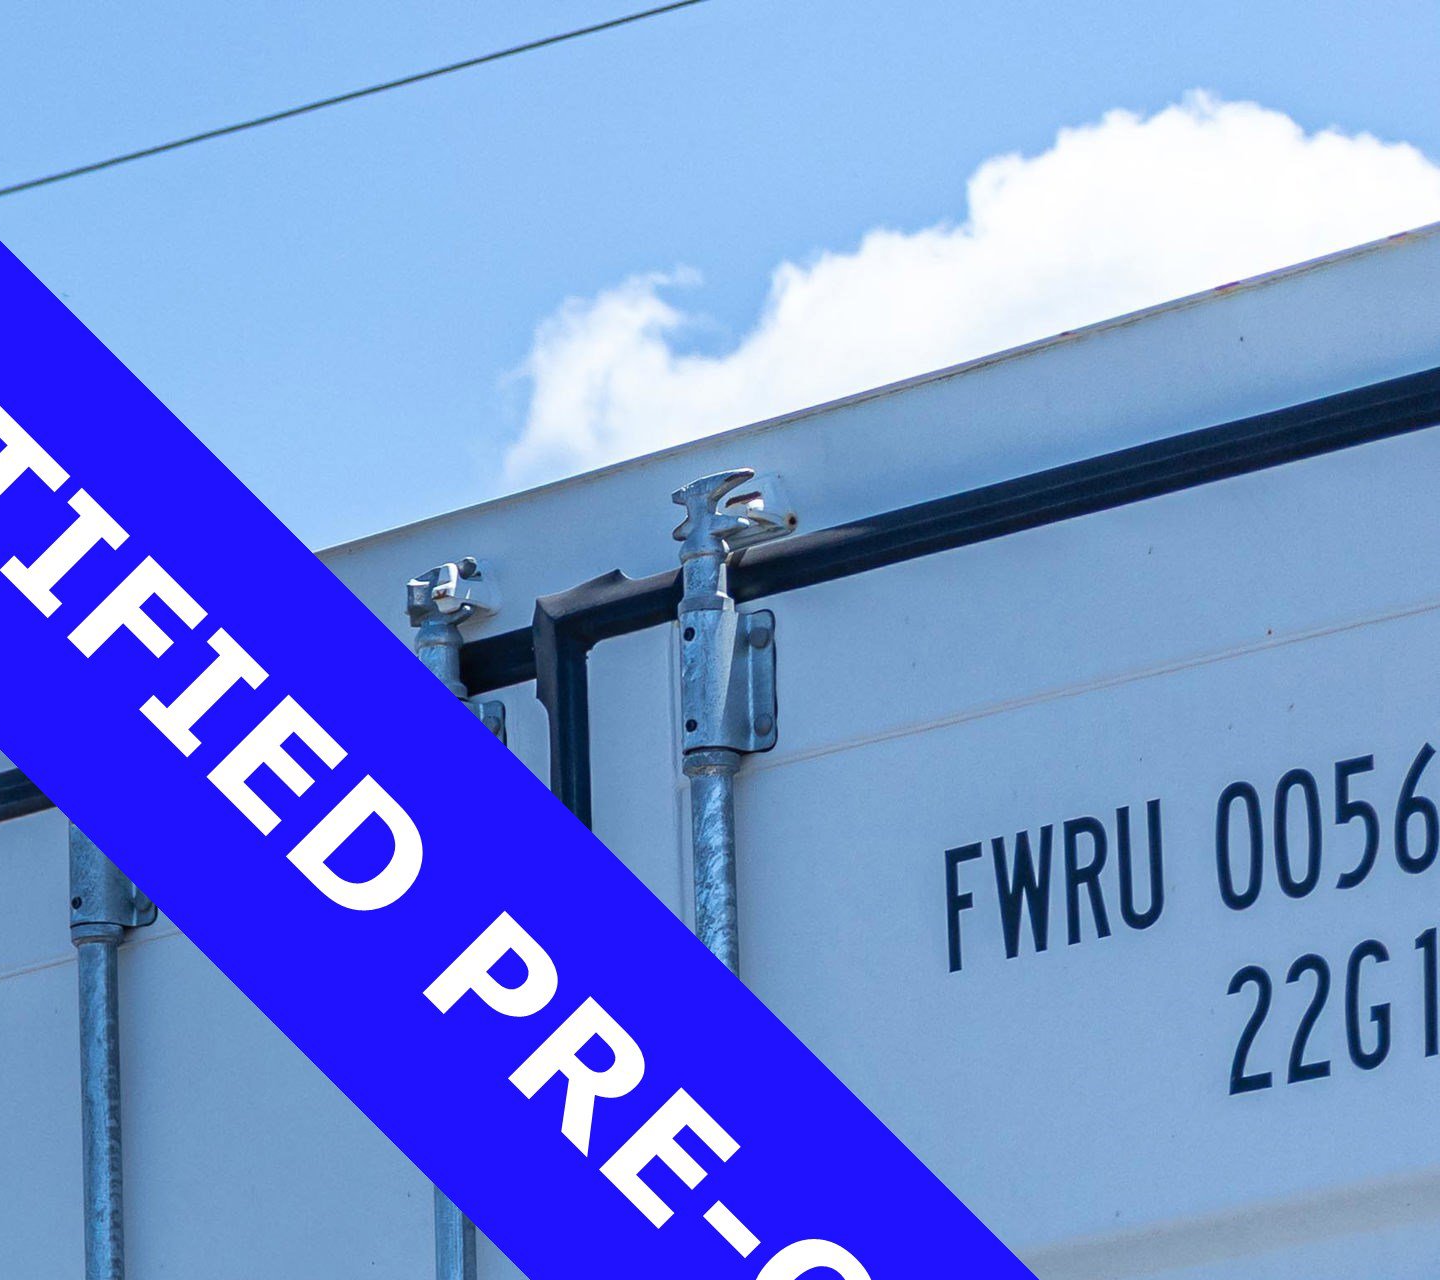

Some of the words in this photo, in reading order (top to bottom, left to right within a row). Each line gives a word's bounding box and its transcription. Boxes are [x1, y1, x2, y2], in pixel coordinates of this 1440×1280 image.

[944, 798, 1165, 973] FWRU
[1215, 742, 1440, 911] 0056
[1226, 926, 1440, 1096] 22G1
